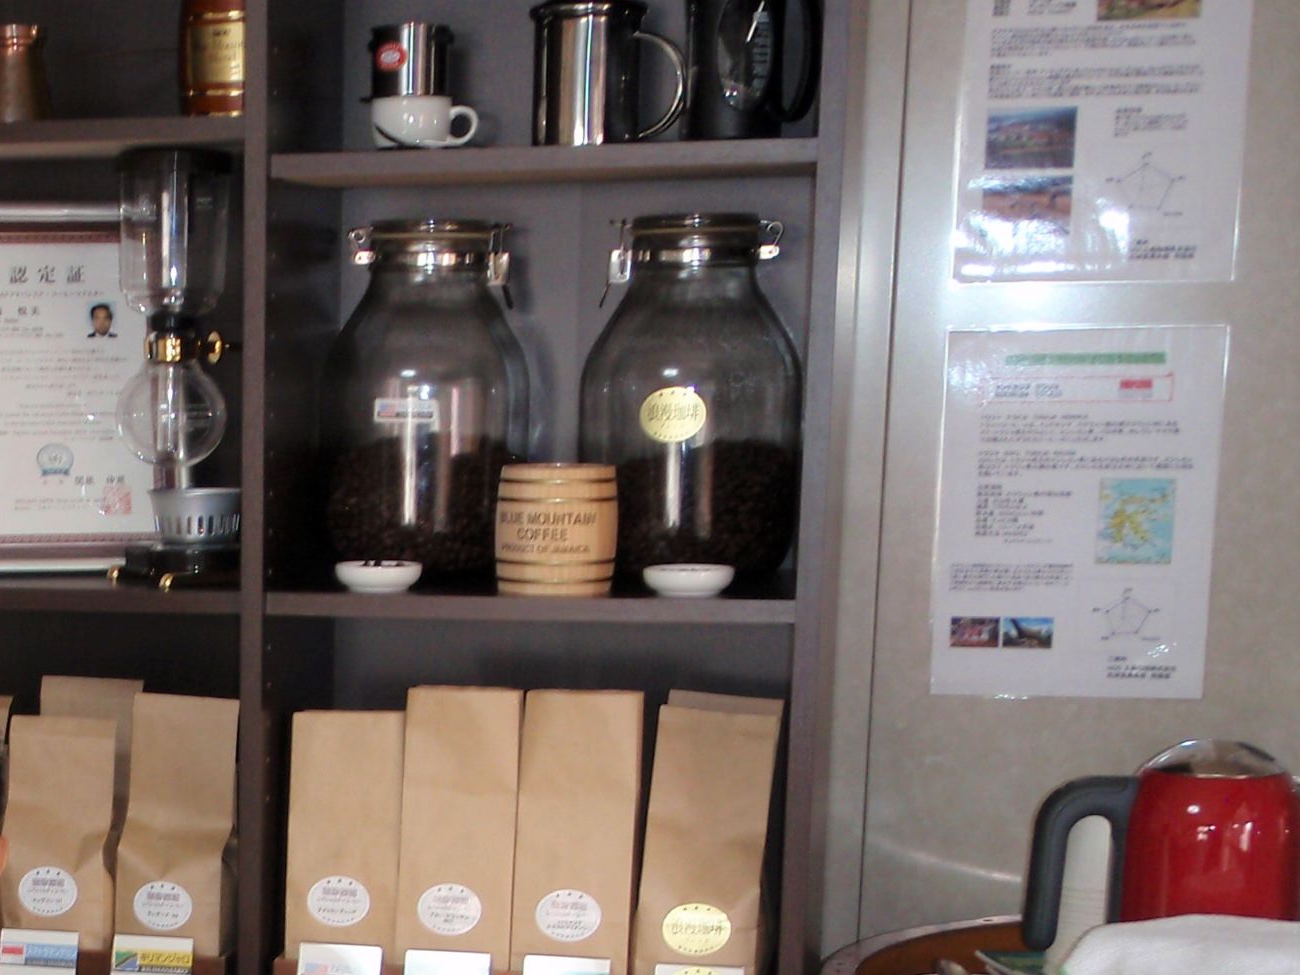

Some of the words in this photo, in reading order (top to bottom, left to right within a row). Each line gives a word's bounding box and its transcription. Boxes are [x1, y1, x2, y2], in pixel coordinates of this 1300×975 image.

[9, 264, 86, 284] 認定証
[528, 511, 597, 526] MOUNTAIN
[516, 527, 568, 541] COFFEE
